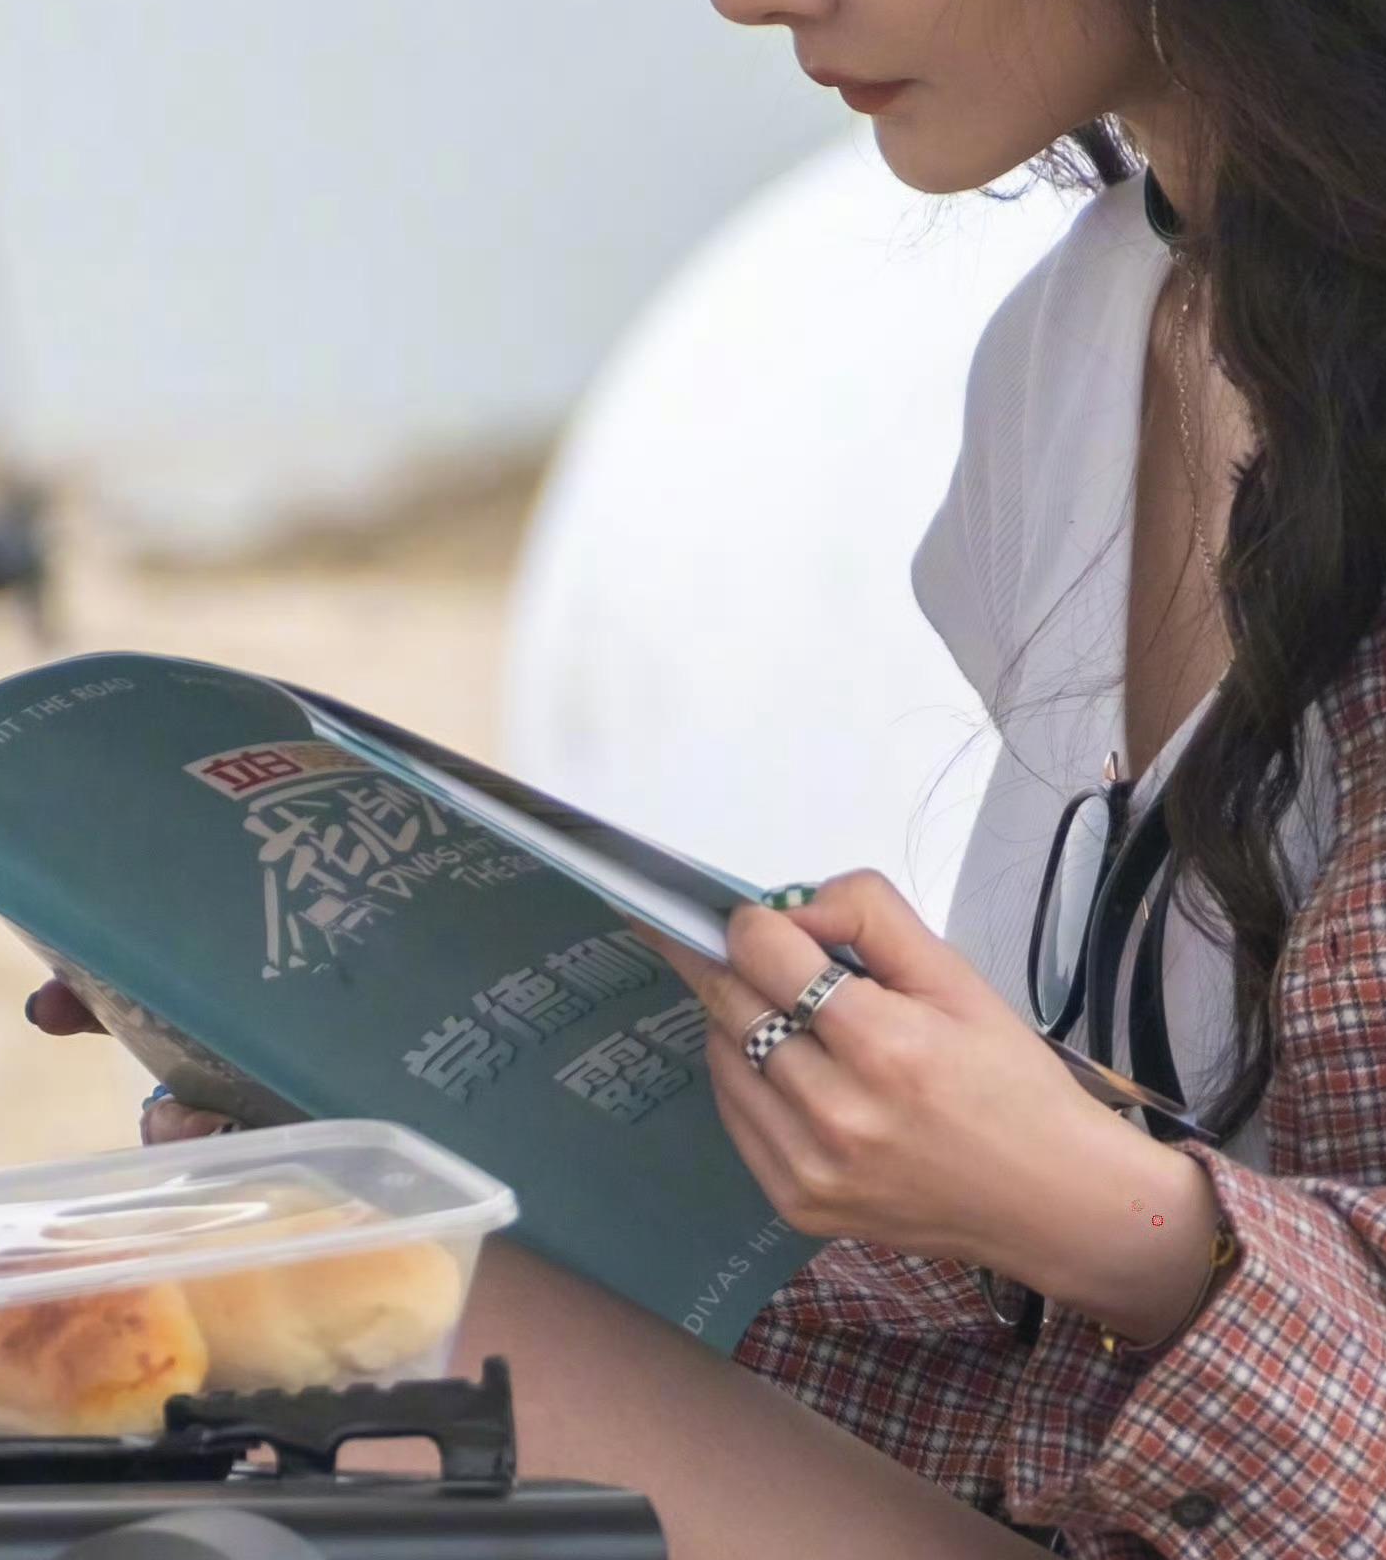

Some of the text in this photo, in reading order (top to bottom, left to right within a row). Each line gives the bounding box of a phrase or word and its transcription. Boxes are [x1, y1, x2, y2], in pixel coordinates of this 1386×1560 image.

[23, 692, 73, 723] THE
[74, 675, 136, 704] ROAD
[201, 749, 303, 792] 立白
[366, 845, 461, 898] DIVAS
[683, 1216, 790, 1335] DIVAS HIT
